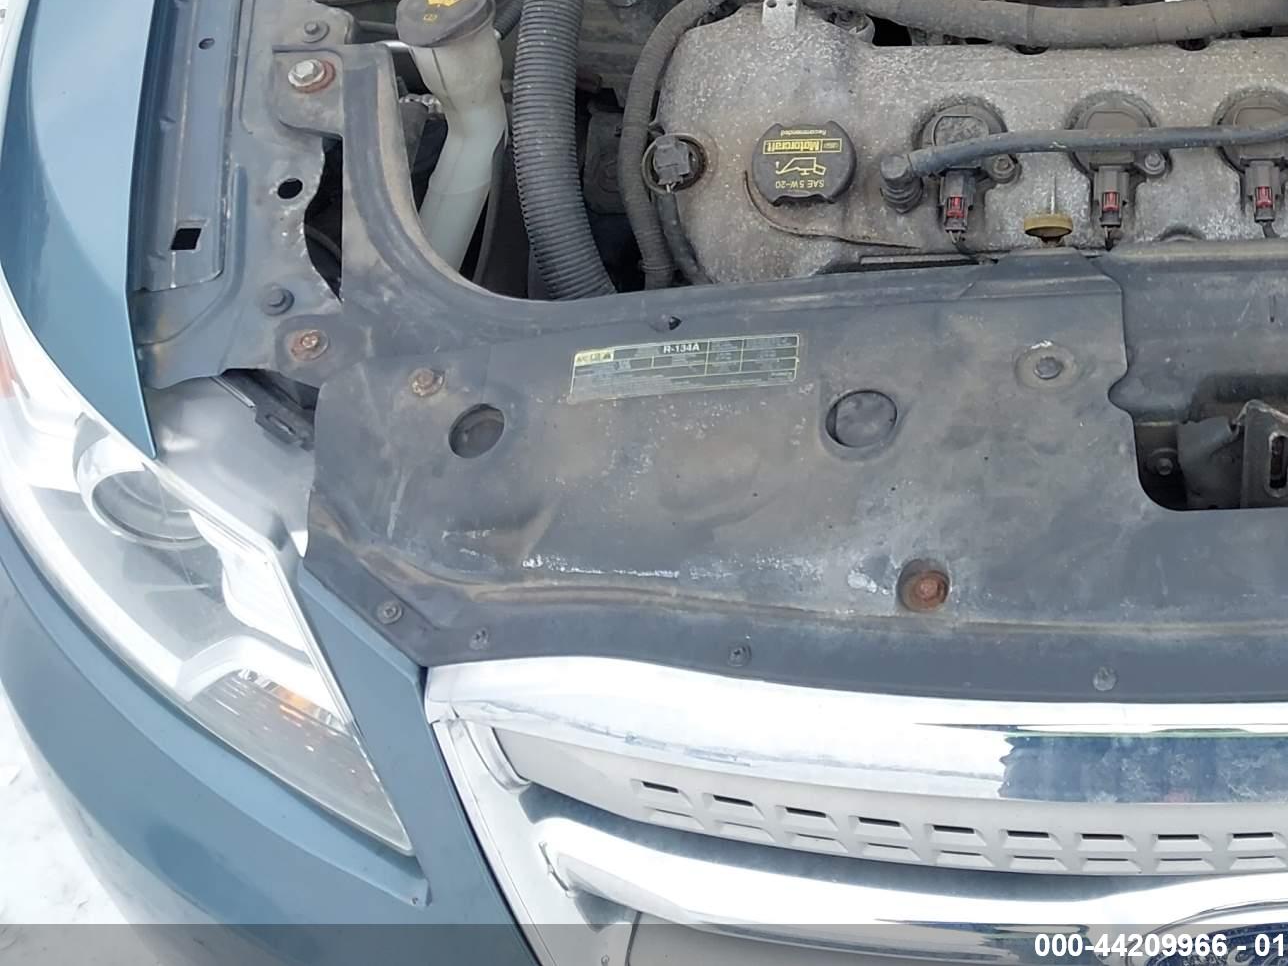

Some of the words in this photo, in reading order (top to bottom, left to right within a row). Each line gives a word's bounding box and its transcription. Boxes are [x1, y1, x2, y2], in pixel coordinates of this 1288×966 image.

[767, 140, 820, 152] Motorcraft
[807, 179, 825, 188] SAE
[663, 343, 700, 354] R-134A
